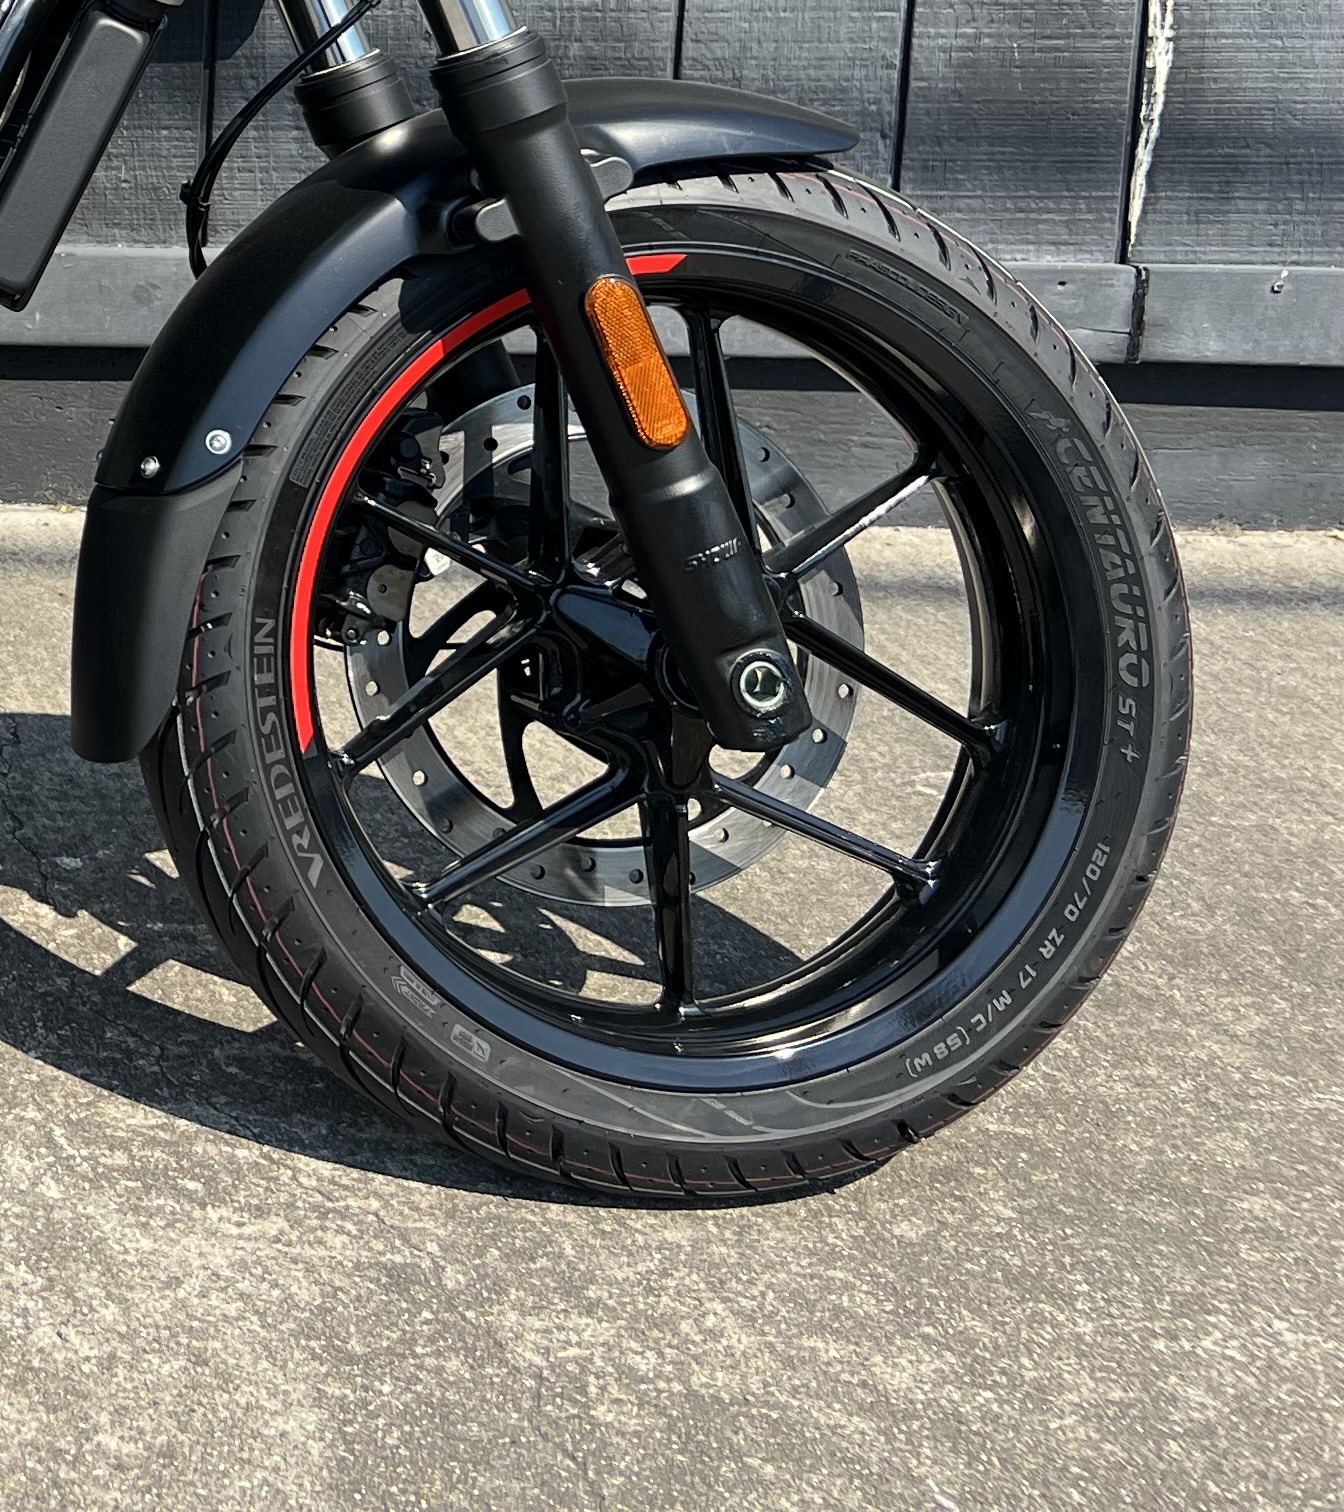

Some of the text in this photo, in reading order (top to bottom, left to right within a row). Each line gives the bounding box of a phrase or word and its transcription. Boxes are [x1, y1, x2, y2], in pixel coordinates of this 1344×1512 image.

[1055, 437, 1151, 689] CENTAURO
[253, 616, 324, 888] VREDESTEIN
[1063, 841, 1111, 922] 120/70
[1038, 927, 1065, 959] ZR
[1018, 964, 1037, 989] 17
[970, 989, 1013, 1032] M/C
